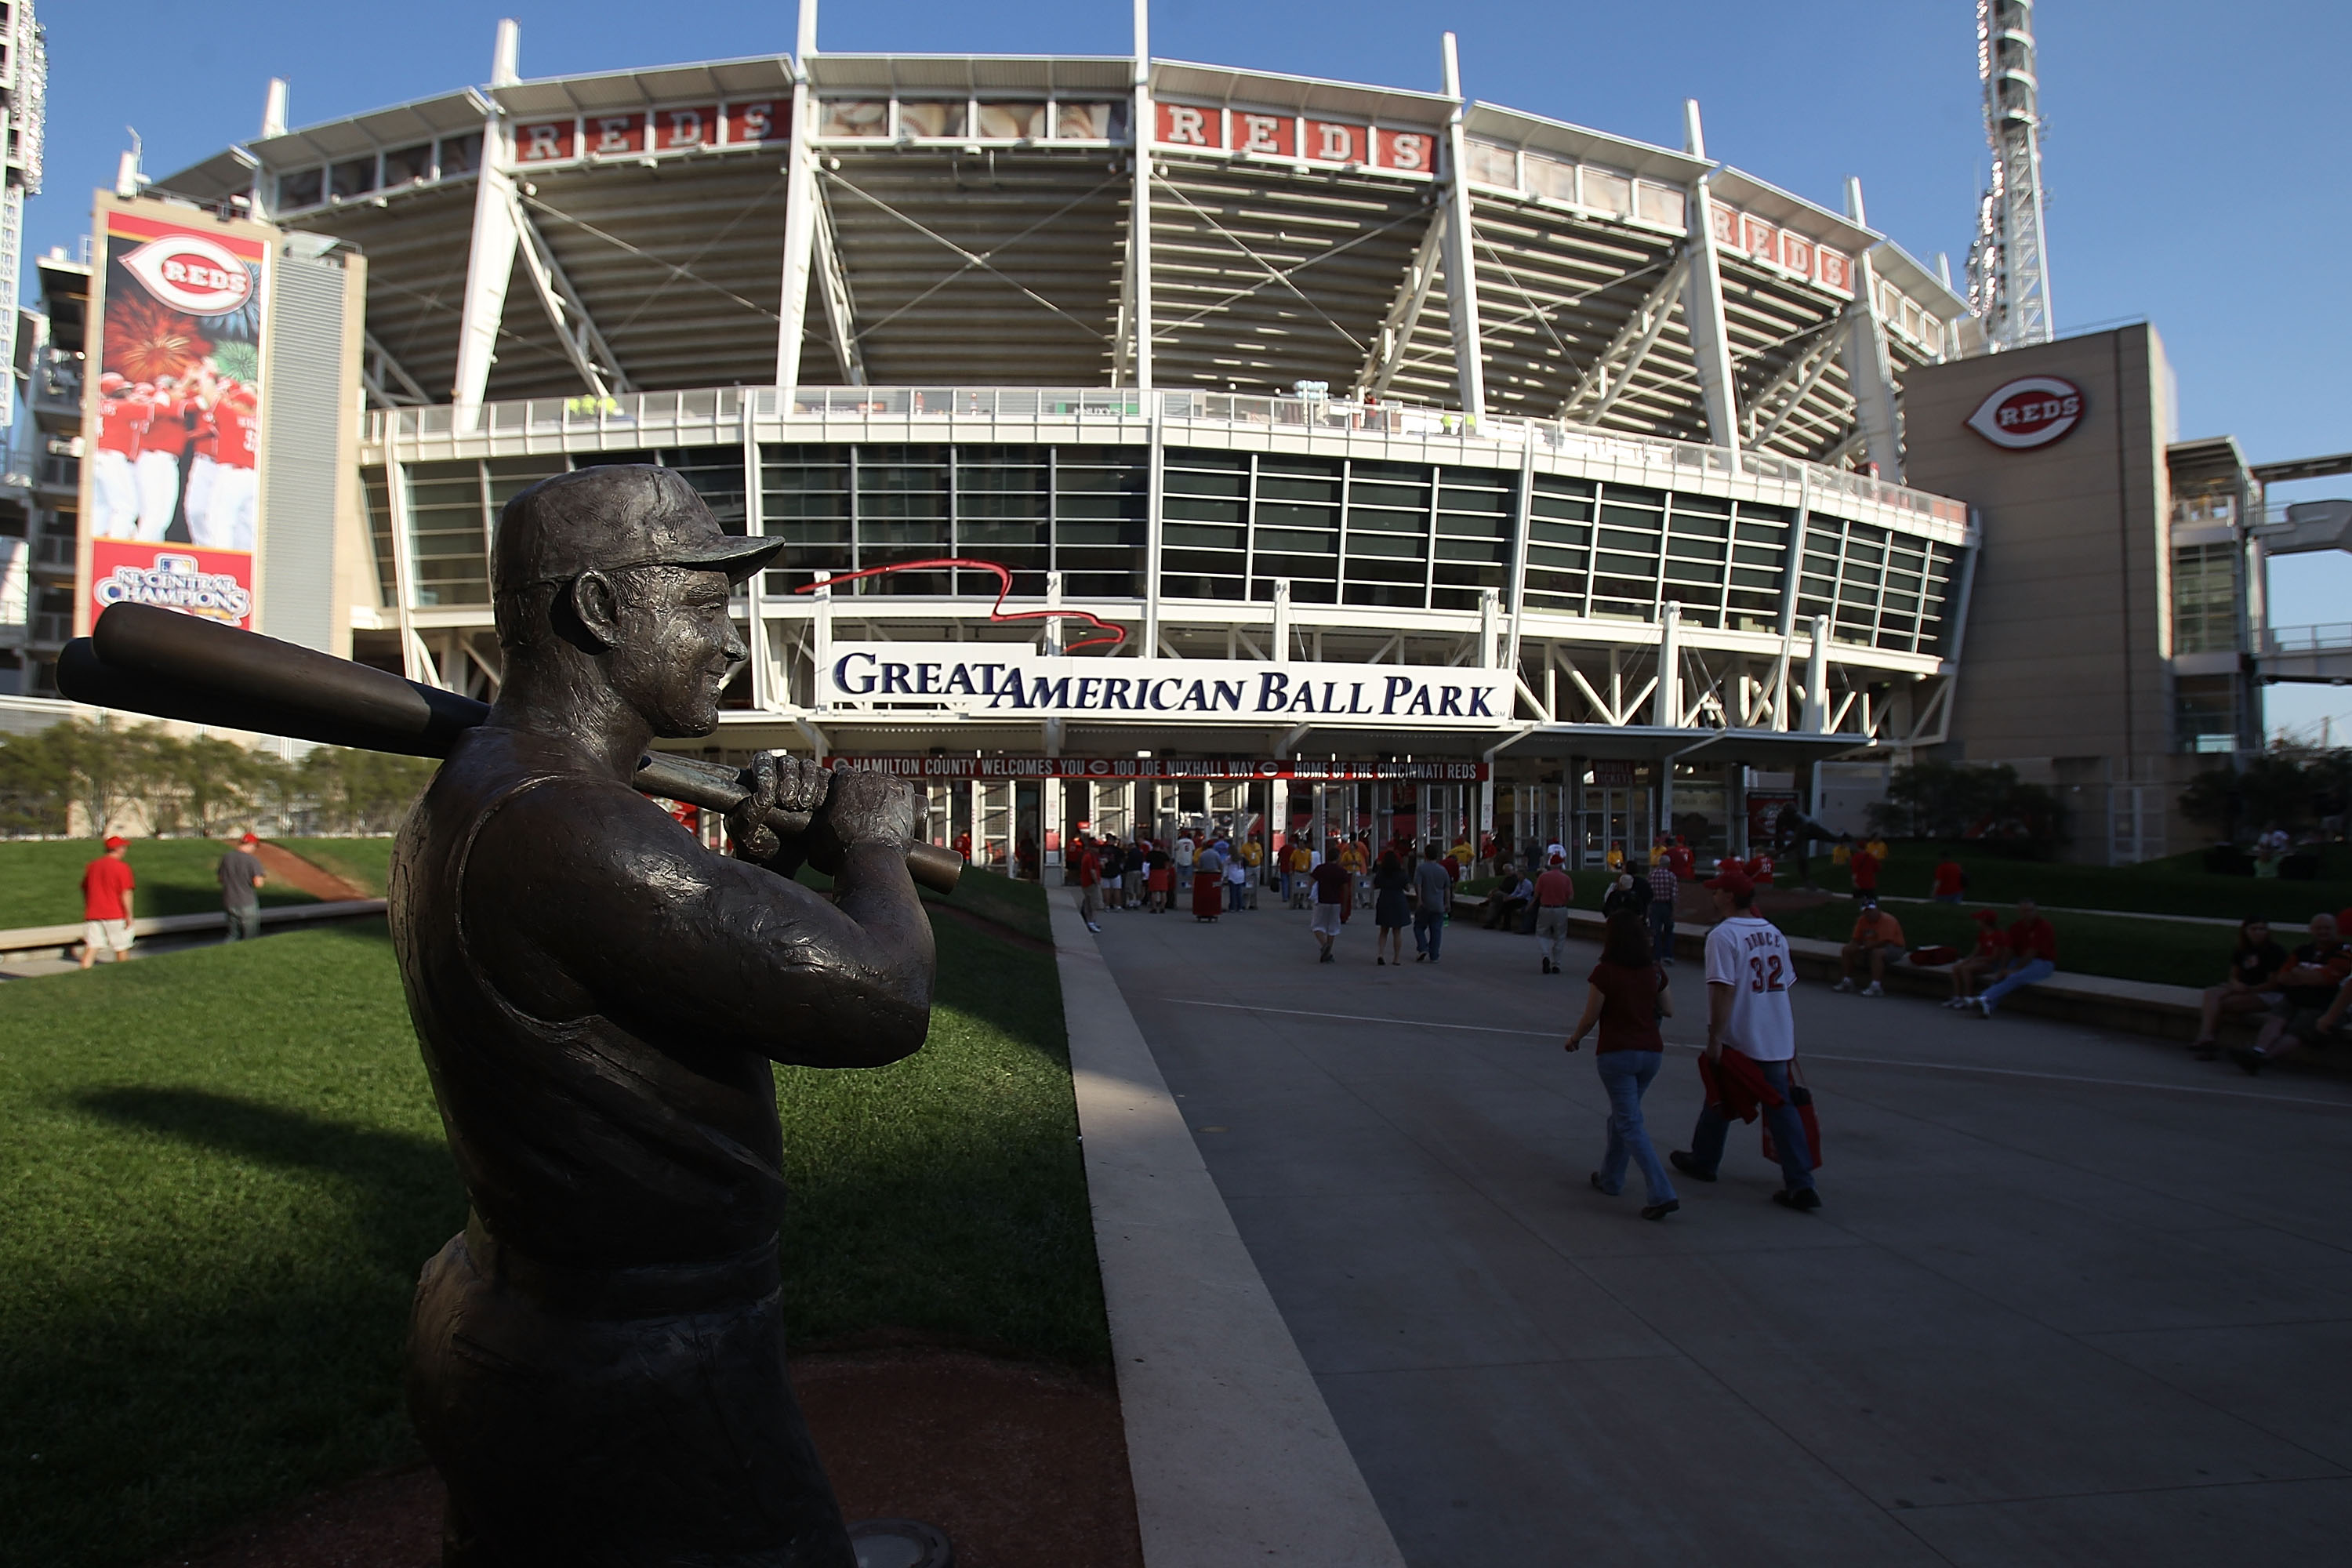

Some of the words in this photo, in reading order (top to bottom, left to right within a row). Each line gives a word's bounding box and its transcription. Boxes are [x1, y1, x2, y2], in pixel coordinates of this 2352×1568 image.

[526, 104, 774, 160] REDS
[1167, 105, 1421, 169] REDS
[1712, 209, 1842, 286] REDS
[164, 260, 247, 294] REDS
[2000, 396, 2079, 426] REDS
[103, 583, 248, 612] CHAMPIONS
[118, 570, 142, 584] NL
[146, 572, 235, 592] CENTRAL
[832, 652, 1006, 695] GREAT
[987, 667, 1248, 711] AMERICAN
[1253, 672, 1374, 714] BALL
[1378, 676, 1497, 717] PARK
[853, 759, 920, 775] HAMILTON
[925, 759, 977, 775] COUNTY
[981, 759, 1054, 775] WELCOMES
[1060, 760, 1086, 776] YOU
[1113, 760, 1136, 776] 100
[1140, 760, 1161, 776] JOE
[1167, 760, 1225, 777] NUXHALL
[1229, 761, 1256, 777] WAY
[1294, 761, 1330, 779] HOME
[1333, 761, 1348, 779] OF
[1352, 762, 1374, 779] THE
[1377, 763, 1443, 779] CINCINNATI
[1447, 763, 1476, 779] REDS
[1750, 955, 1786, 993] 32
